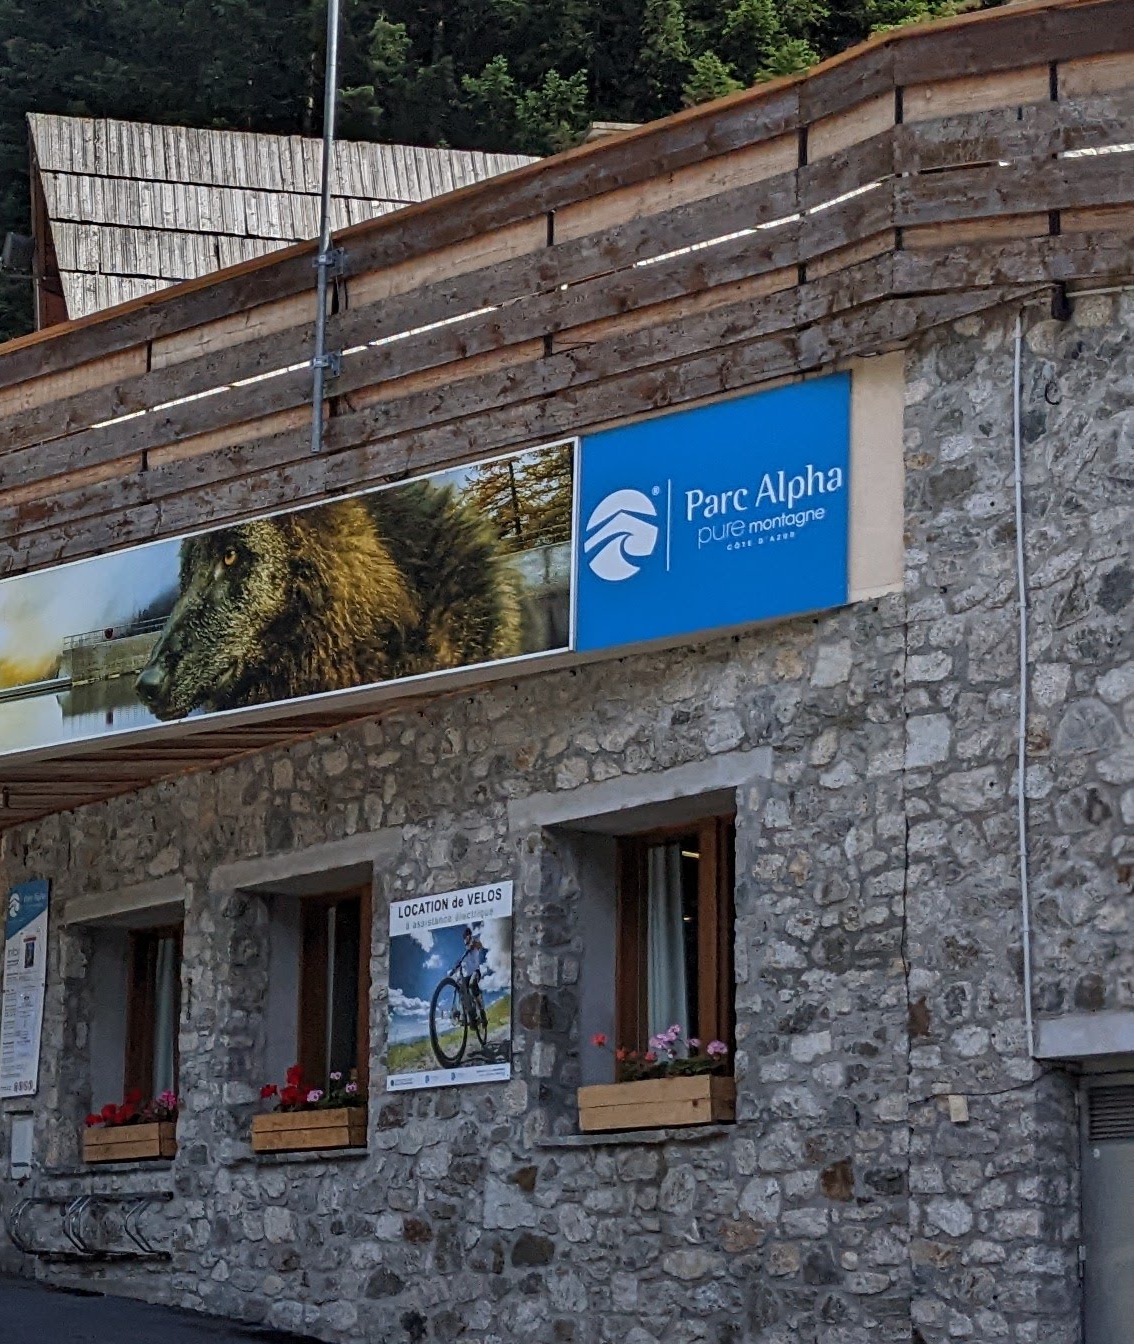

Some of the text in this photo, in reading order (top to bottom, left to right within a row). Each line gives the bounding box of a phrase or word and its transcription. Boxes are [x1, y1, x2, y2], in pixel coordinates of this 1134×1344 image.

[684, 464, 842, 522] Parc Alpha
[698, 508, 826, 550] pure montagne
[398, 888, 502, 918] LOCATION de VELOS
[412, 916, 452, 929] assistance
[455, 907, 494, 923] électrique
